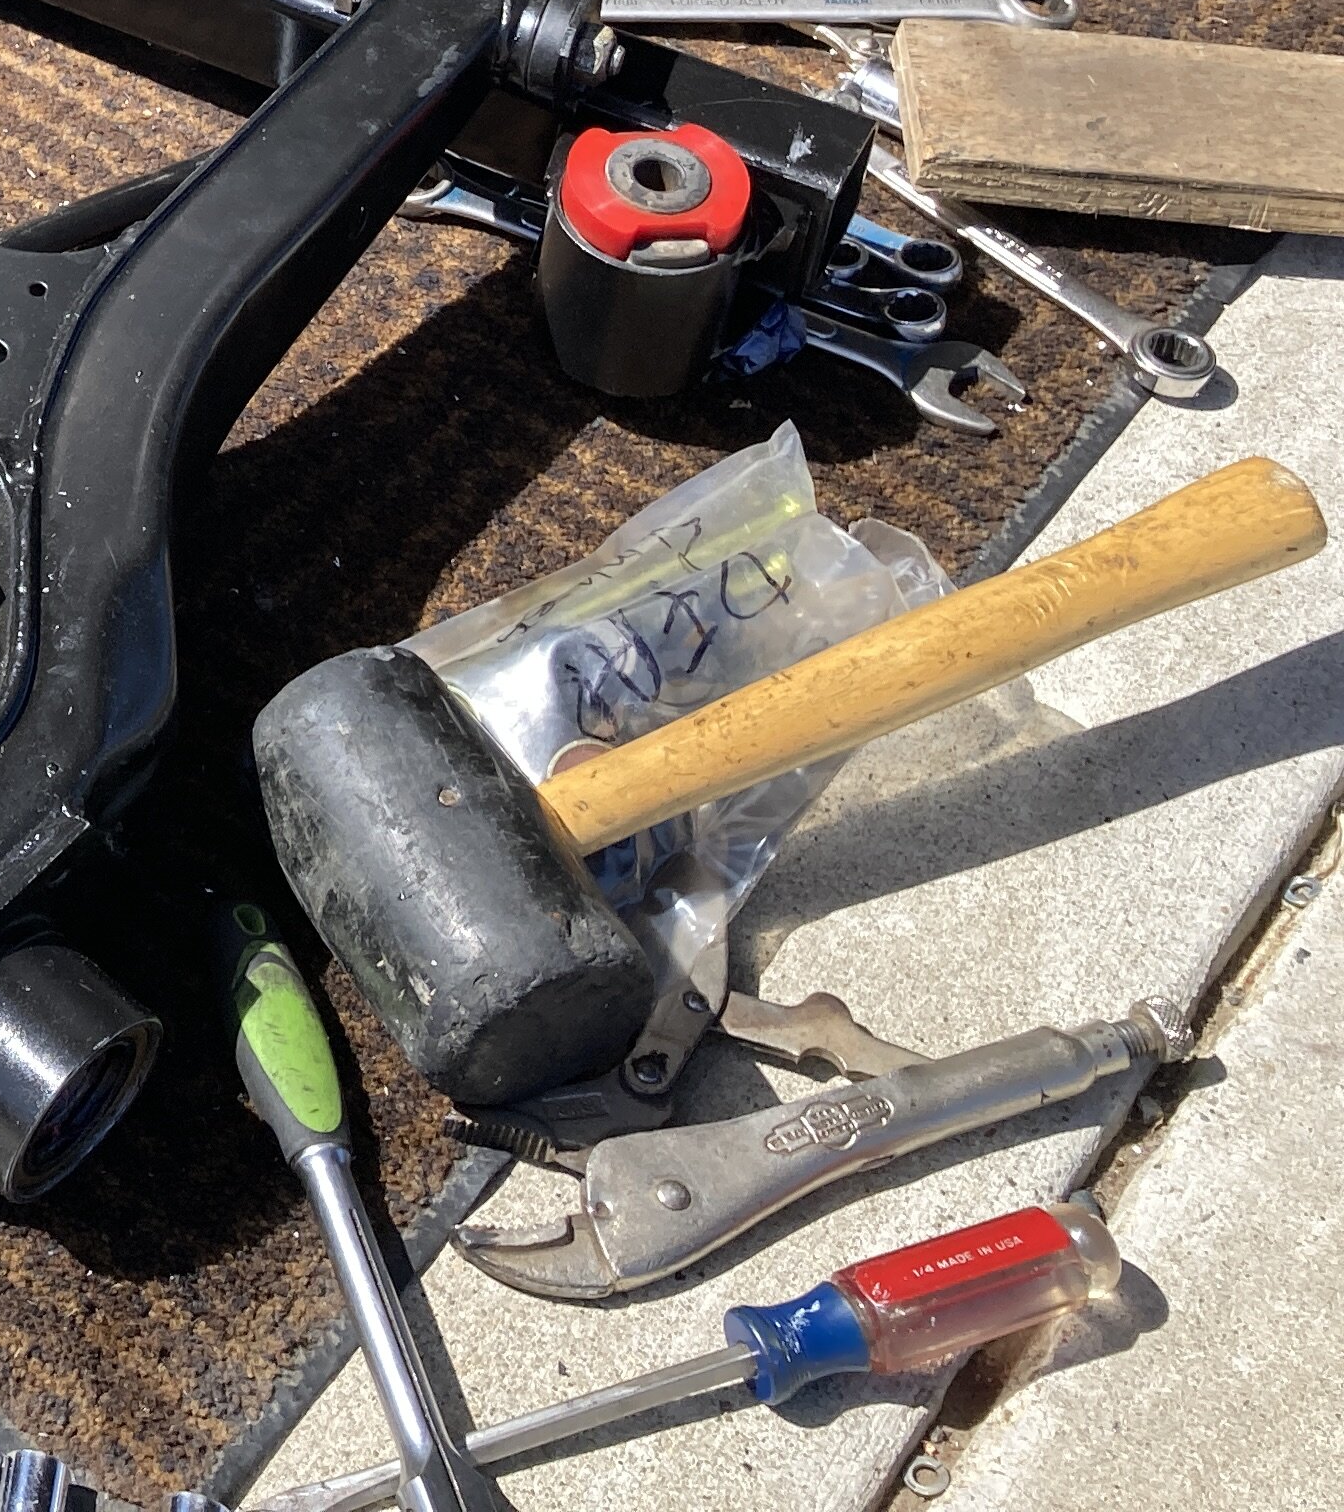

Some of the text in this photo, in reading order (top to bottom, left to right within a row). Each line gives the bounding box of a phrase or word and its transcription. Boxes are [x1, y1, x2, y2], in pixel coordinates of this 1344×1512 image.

[912, 1235, 1024, 1278] 1/4 MADE IN USA
